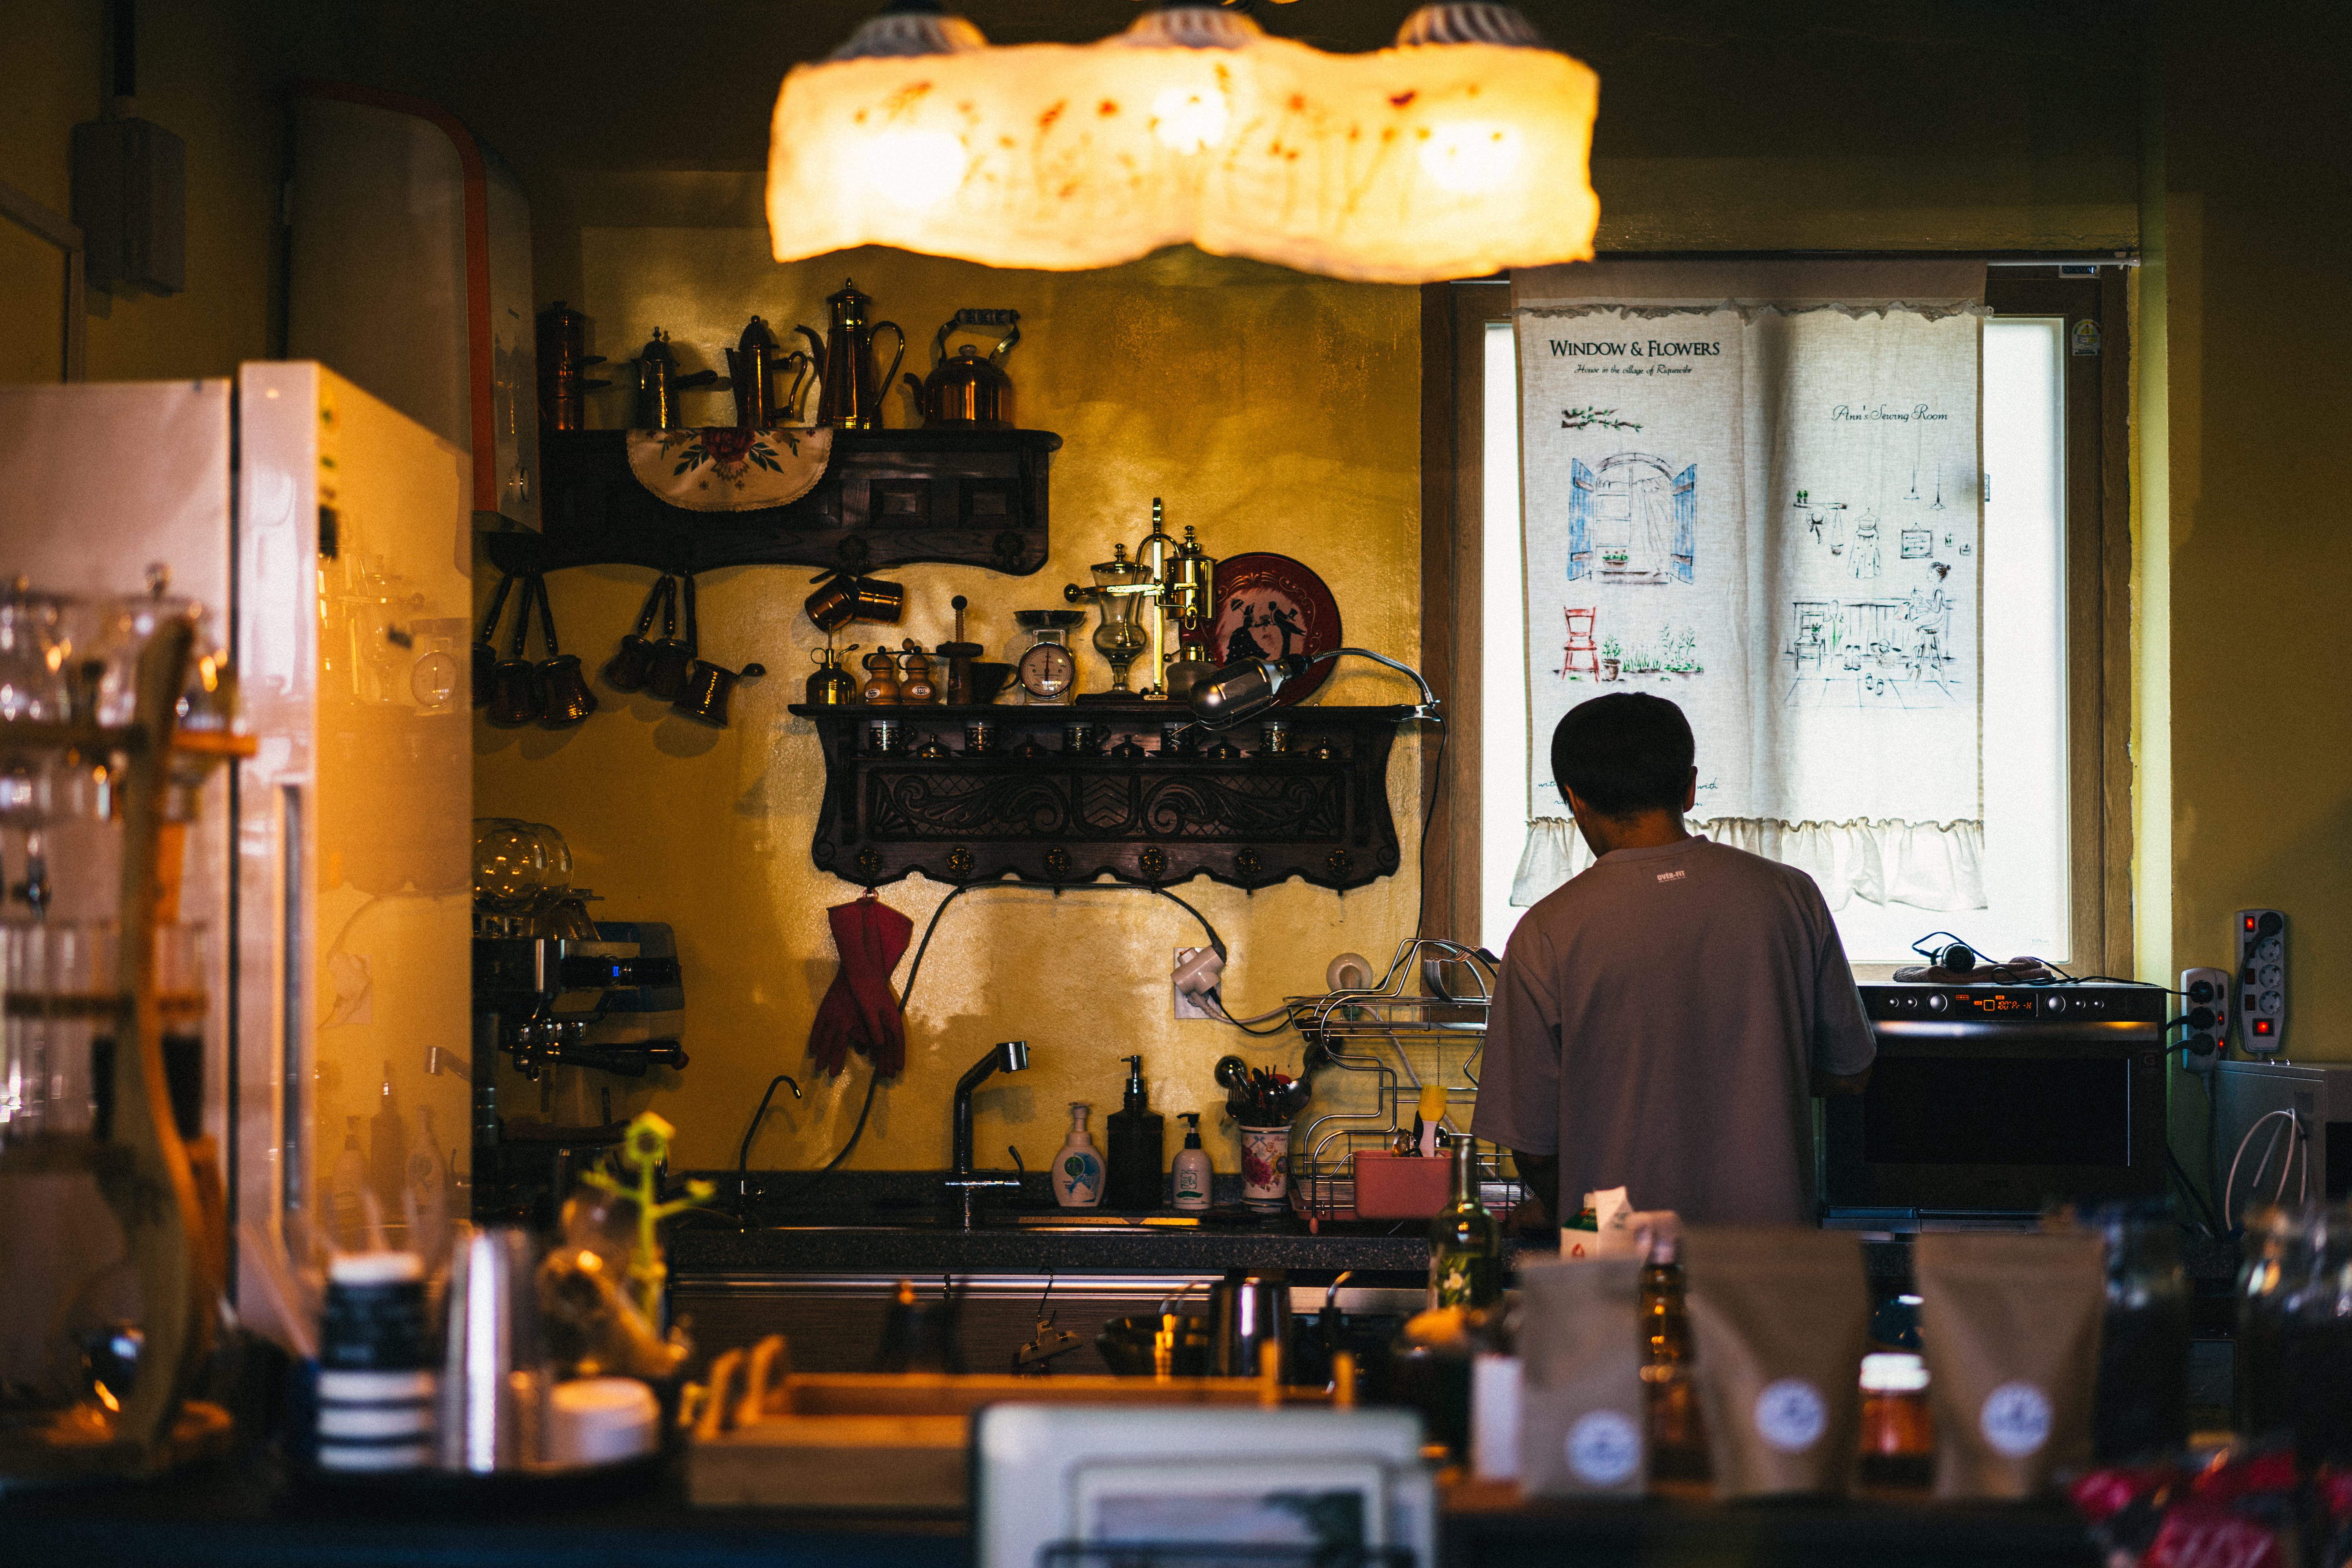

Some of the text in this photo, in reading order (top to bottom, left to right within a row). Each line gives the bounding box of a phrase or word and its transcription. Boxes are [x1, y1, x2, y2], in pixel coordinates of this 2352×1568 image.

[1549, 340, 1720, 357] WINDOW & FLOWERS
[1574, 364, 1599, 374] House
[1611, 364, 1620, 373] the
[1622, 364, 1644, 376] village
[1646, 364, 1654, 376] of
[1656, 364, 1693, 376] Riquewihr
[1831, 404, 1948, 423] Ann's Sewing Room
[1697, 777, 1719, 789] with
